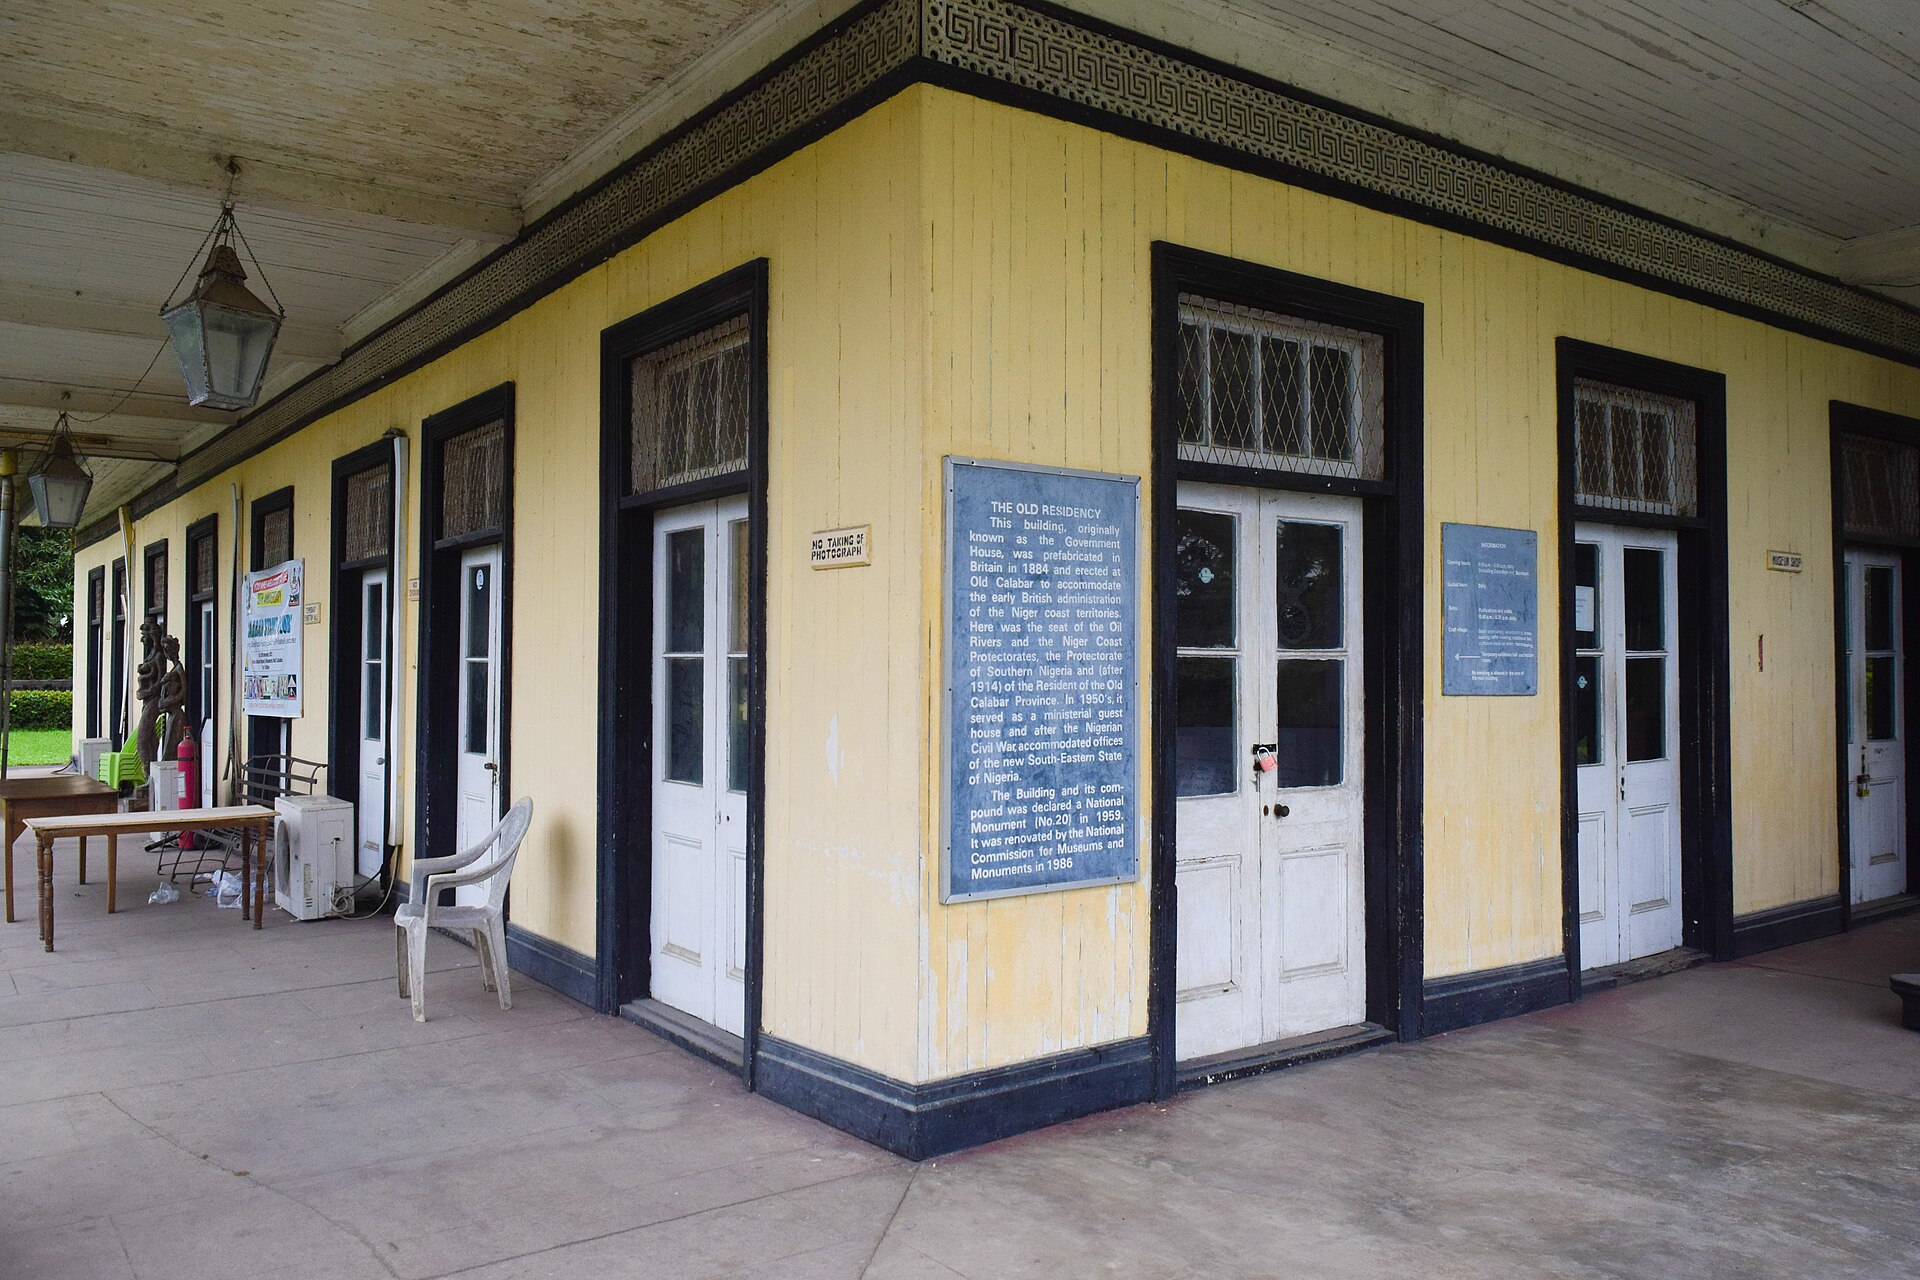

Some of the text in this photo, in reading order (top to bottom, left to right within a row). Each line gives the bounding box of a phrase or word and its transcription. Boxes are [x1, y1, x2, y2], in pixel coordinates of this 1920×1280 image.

[991, 501, 1101, 519] THE OLD RESIDENCY
[990, 517, 1011, 528] This
[1078, 525, 1120, 536] originally
[813, 534, 863, 549] NO TAKING OF
[970, 531, 1120, 548] known as the Government
[812, 546, 861, 560] PHOTOGRAPH
[970, 546, 1120, 562] House, was prefabricated in
[971, 562, 1120, 577] Britain in 1884 and erected at
[971, 576, 1121, 590] Old Calabar to accommodate
[970, 592, 1121, 604] the early British administration
[970, 607, 1121, 620] of the Niger coast territories.
[970, 621, 1122, 632] Here was the seat of the Oil
[971, 636, 1122, 648] Rivers and the Niger Coast
[971, 650, 1122, 662] Protectorates, the Protectorate
[970, 665, 1123, 678] of Southern Nigeria and (after
[971, 680, 1122, 693] 1914) of the Resident of the Old
[971, 696, 1009, 708] Calabar
[1016, 695, 1058, 706] Province.
[1066, 694, 1074, 704] In
[1117, 694, 1122, 703] it
[971, 708, 1123, 723] served as a ministerial guest
[971, 722, 1122, 738] house and after the Nigerian
[971, 743, 993, 754] Civil
[1019, 737, 1091, 751] accommodated
[1093, 736, 1123, 746] offices
[969, 751, 1122, 770] of the new South-Eastern State
[969, 771, 1021, 785] of Nigeria.
[991, 782, 1123, 801] The Building and its com-
[971, 796, 1124, 820] pound was declared a National
[971, 819, 1026, 834] Monument
[1080, 813, 1088, 823] in
[1097, 811, 1123, 822] 1959.
[971, 824, 1124, 848] It was renovated by the National
[971, 838, 1123, 864] Commission for Museums and
[972, 857, 1072, 879] Monuments in 1986
